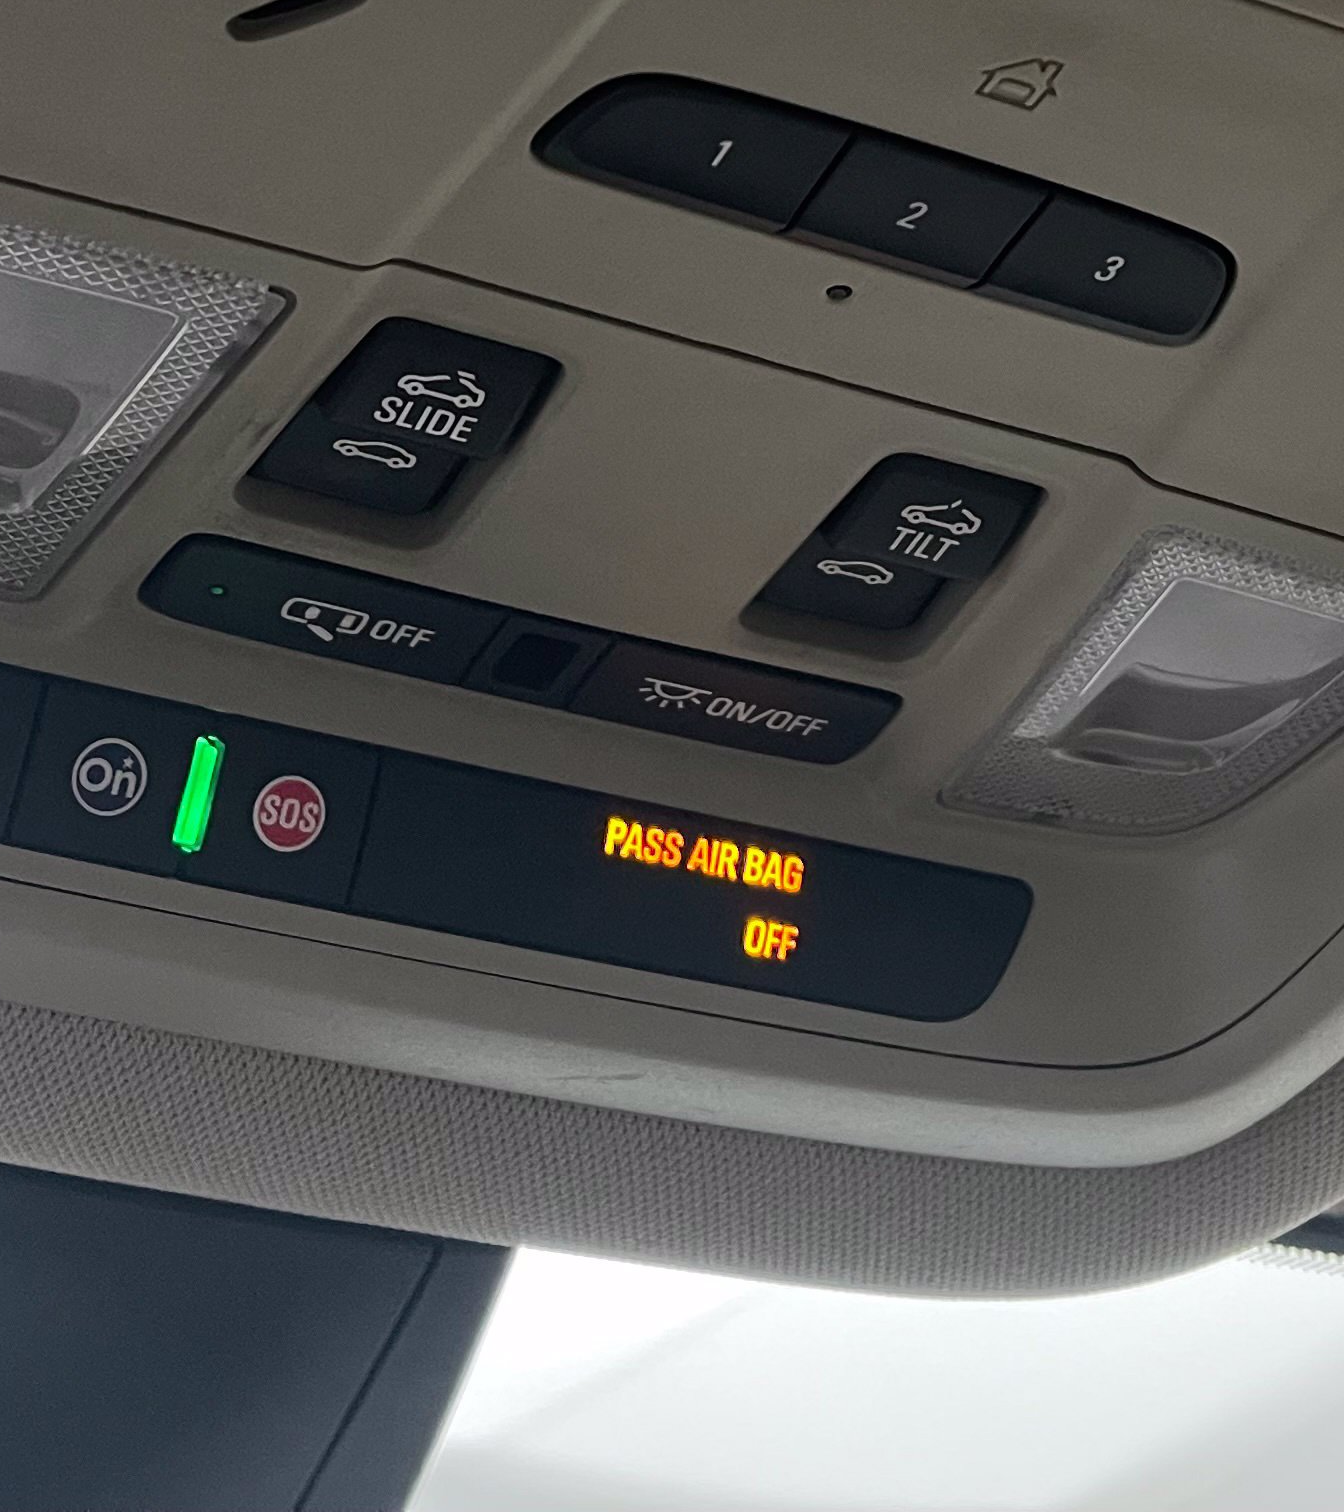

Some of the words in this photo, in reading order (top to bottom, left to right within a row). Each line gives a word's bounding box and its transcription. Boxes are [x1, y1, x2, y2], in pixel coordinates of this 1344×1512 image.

[711, 140, 733, 167] 1
[896, 201, 929, 230] 2
[1094, 256, 1125, 282] 3
[373, 396, 479, 444] SLIDE
[889, 527, 961, 563] TILT
[369, 619, 436, 649] OFF
[705, 694, 829, 737] ON/OFF
[79, 757, 136, 798] On
[259, 793, 320, 834] SOS
[603, 816, 684, 868] PASS
[686, 837, 739, 881] AIR
[742, 846, 805, 894] BAG
[743, 916, 800, 961] OFF
